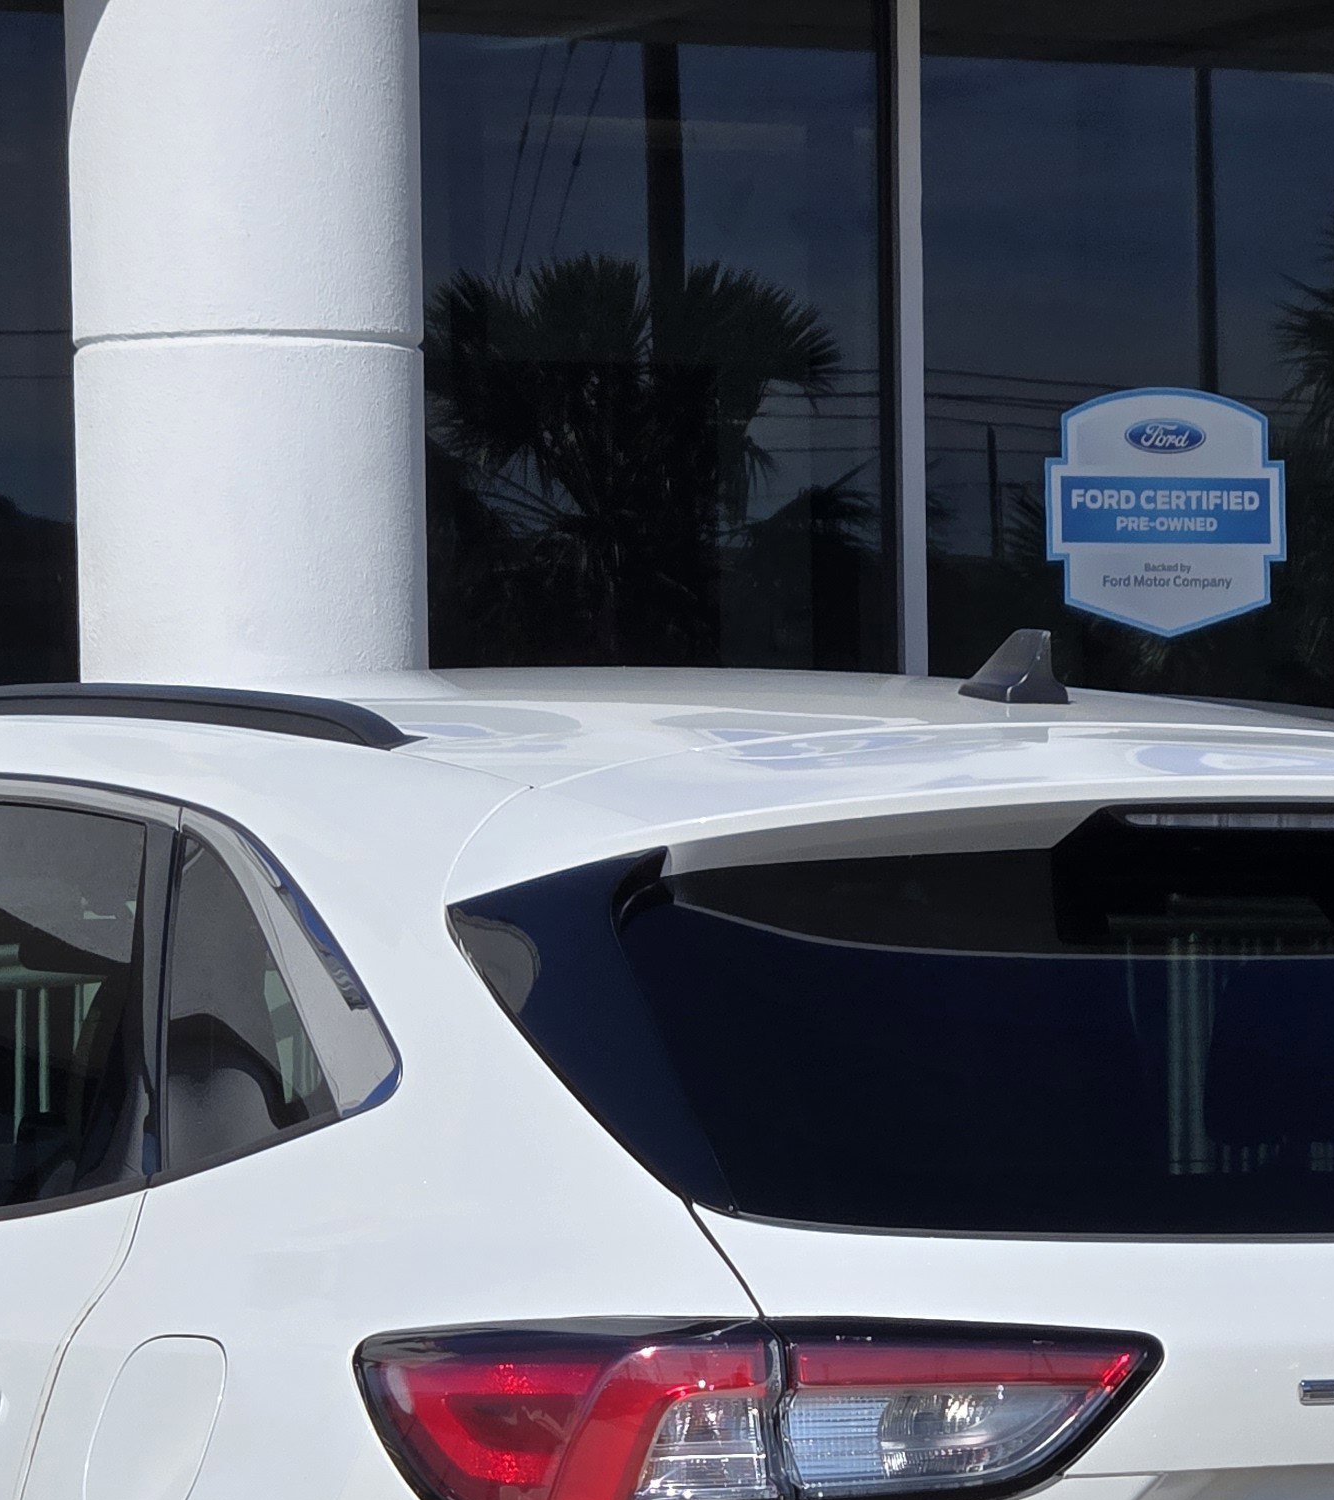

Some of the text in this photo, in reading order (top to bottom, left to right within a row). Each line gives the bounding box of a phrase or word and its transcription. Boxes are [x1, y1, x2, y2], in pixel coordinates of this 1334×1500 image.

[1140, 422, 1191, 448] Ford
[1071, 489, 1260, 511] FORD CERTIFIED
[1116, 516, 1218, 531] PRE-OWNED
[1144, 562, 1192, 574] Backed by
[1102, 575, 1232, 589] Ford Motor Company
